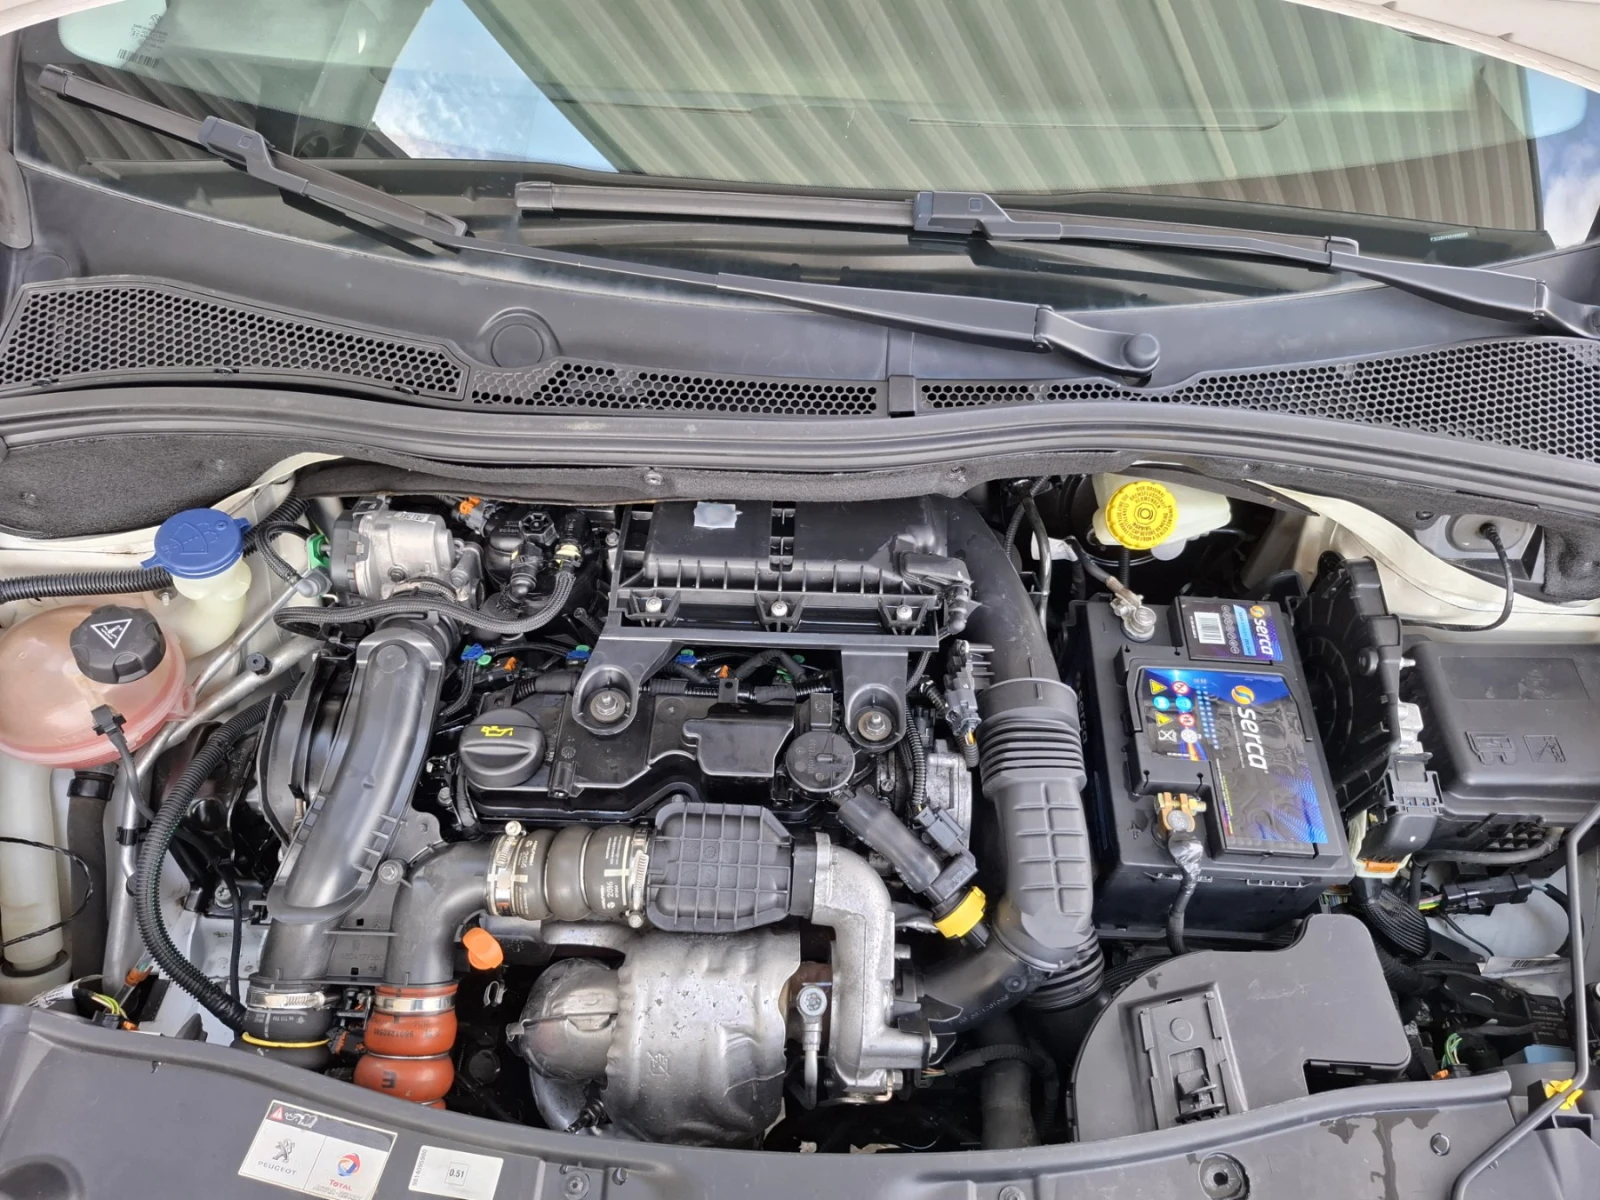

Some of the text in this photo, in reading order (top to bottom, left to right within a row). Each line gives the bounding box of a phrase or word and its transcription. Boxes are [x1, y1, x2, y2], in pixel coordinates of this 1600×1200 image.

[1253, 617, 1273, 656] serca
[1237, 706, 1268, 770] serca
[606, 881, 614, 898] 2016
[257, 1160, 297, 1176] PEUGEOT
[449, 1168, 465, 1179] 0.51
[329, 1179, 353, 1192] TOTAL
